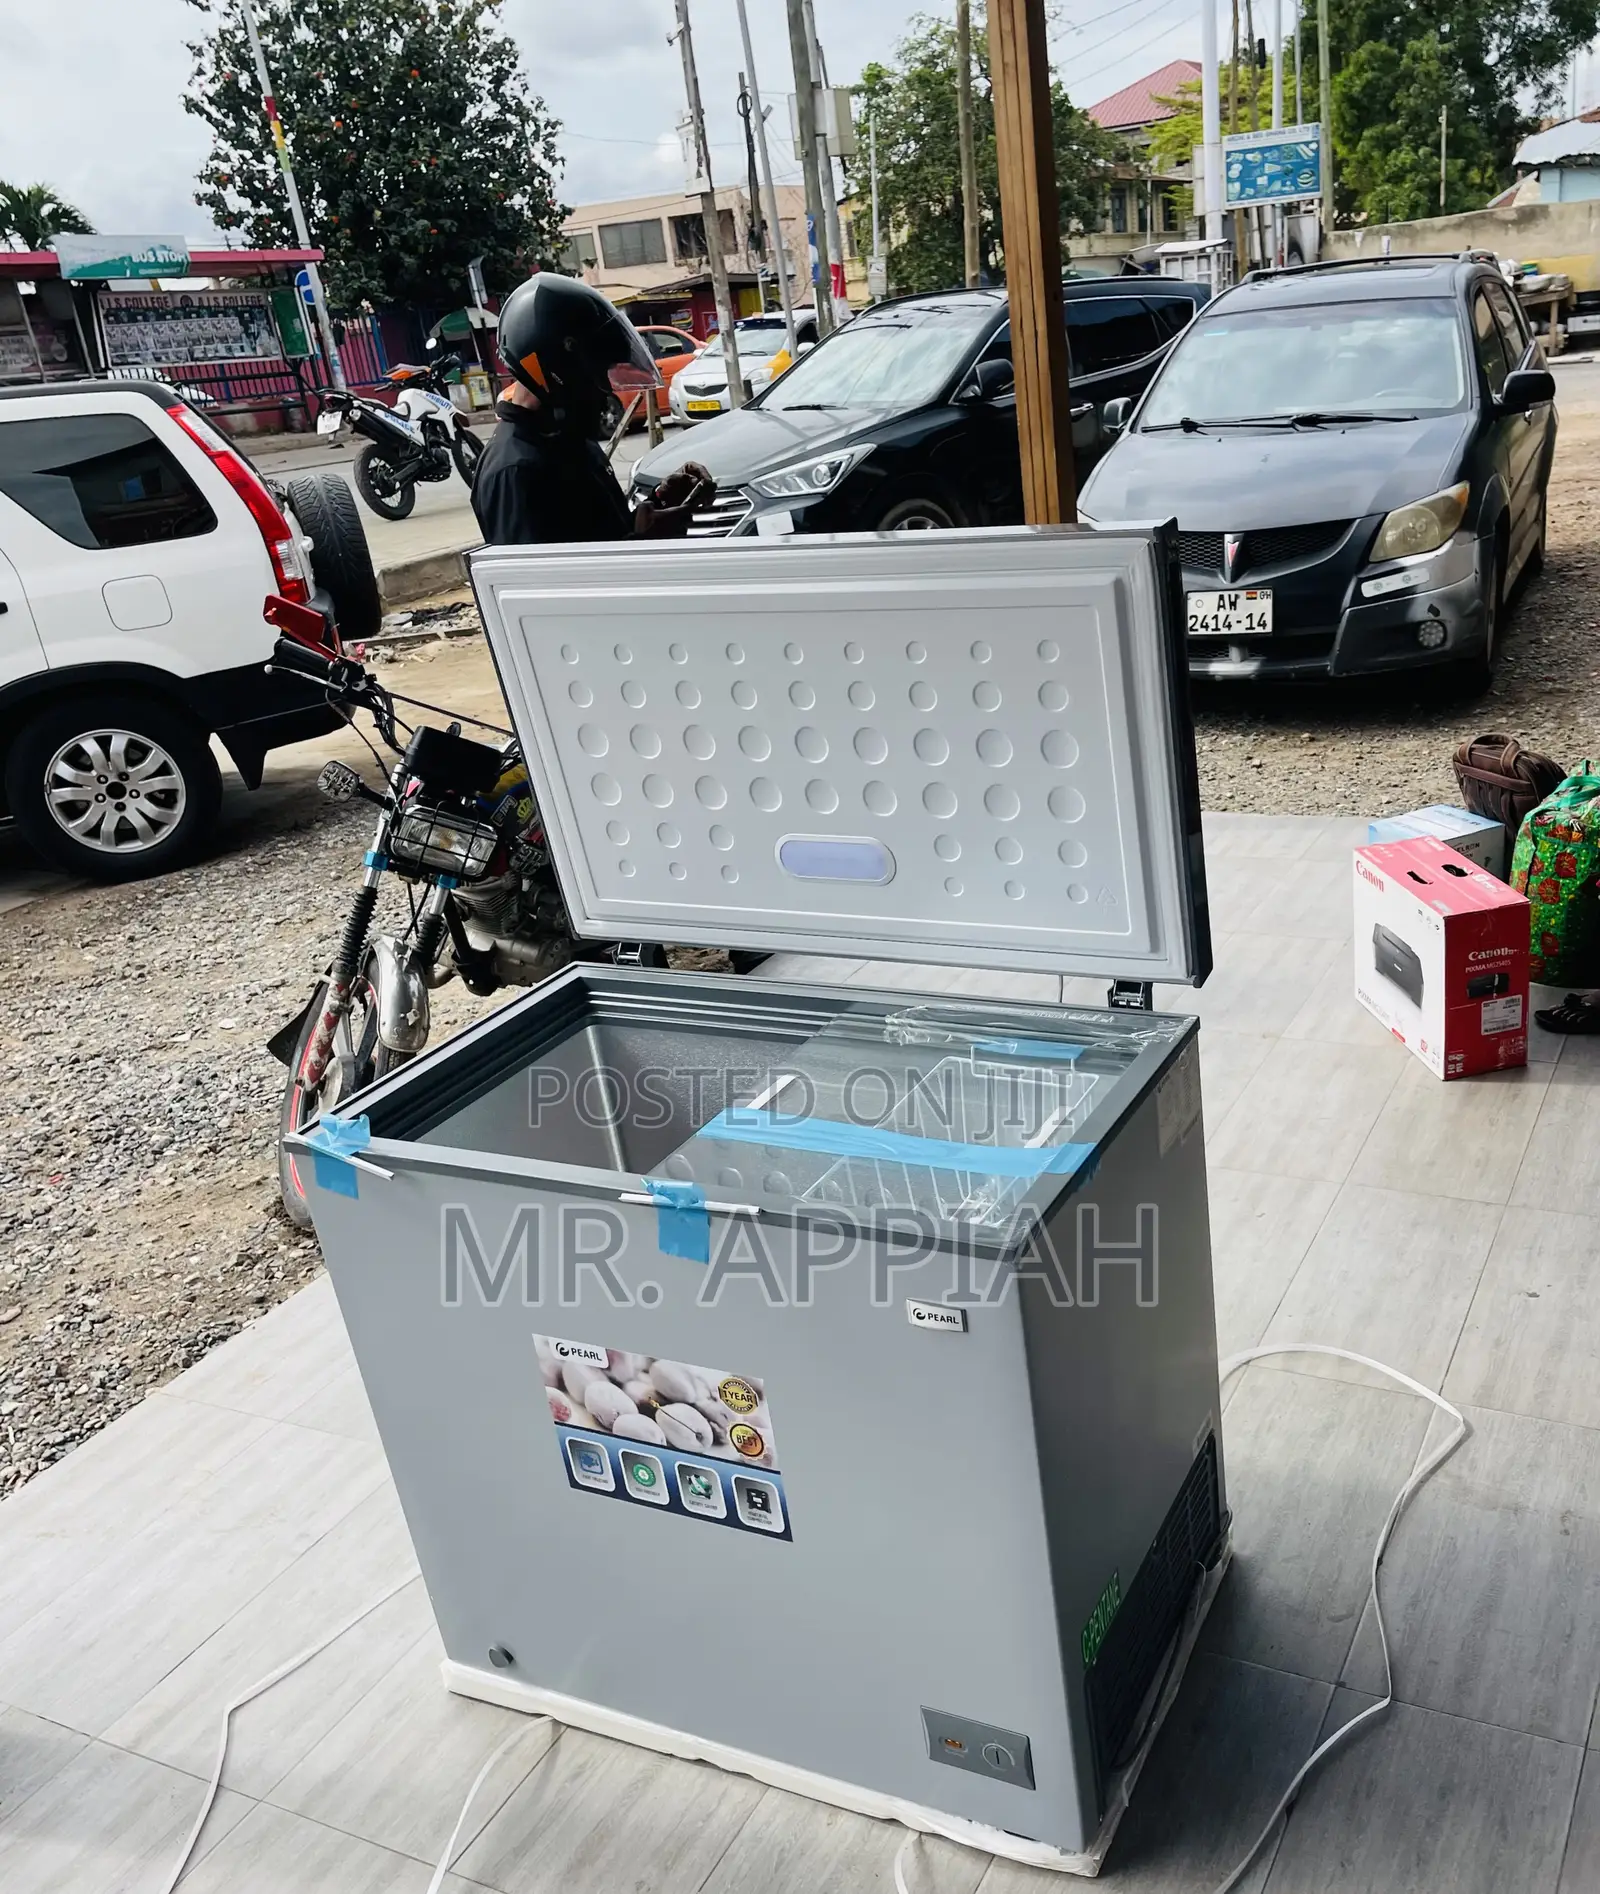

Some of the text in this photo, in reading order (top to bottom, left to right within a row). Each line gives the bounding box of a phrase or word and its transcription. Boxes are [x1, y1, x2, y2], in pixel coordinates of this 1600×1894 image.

[124, 296, 169, 310] COLLEGE
[222, 295, 262, 308] COLLEGE
[1217, 594, 1240, 611] AW
[1260, 591, 1272, 600] GH
[1189, 612, 1267, 632] 2414-14
[1355, 860, 1384, 892] Canon
[1468, 947, 1508, 961] Canon
[1465, 964, 1486, 973] PIXMA
[927, 1312, 960, 1325] PEARL
[570, 1347, 603, 1362] PEARL
[728, 1391, 753, 1403] YEAR
[736, 1433, 758, 1448] BEST
